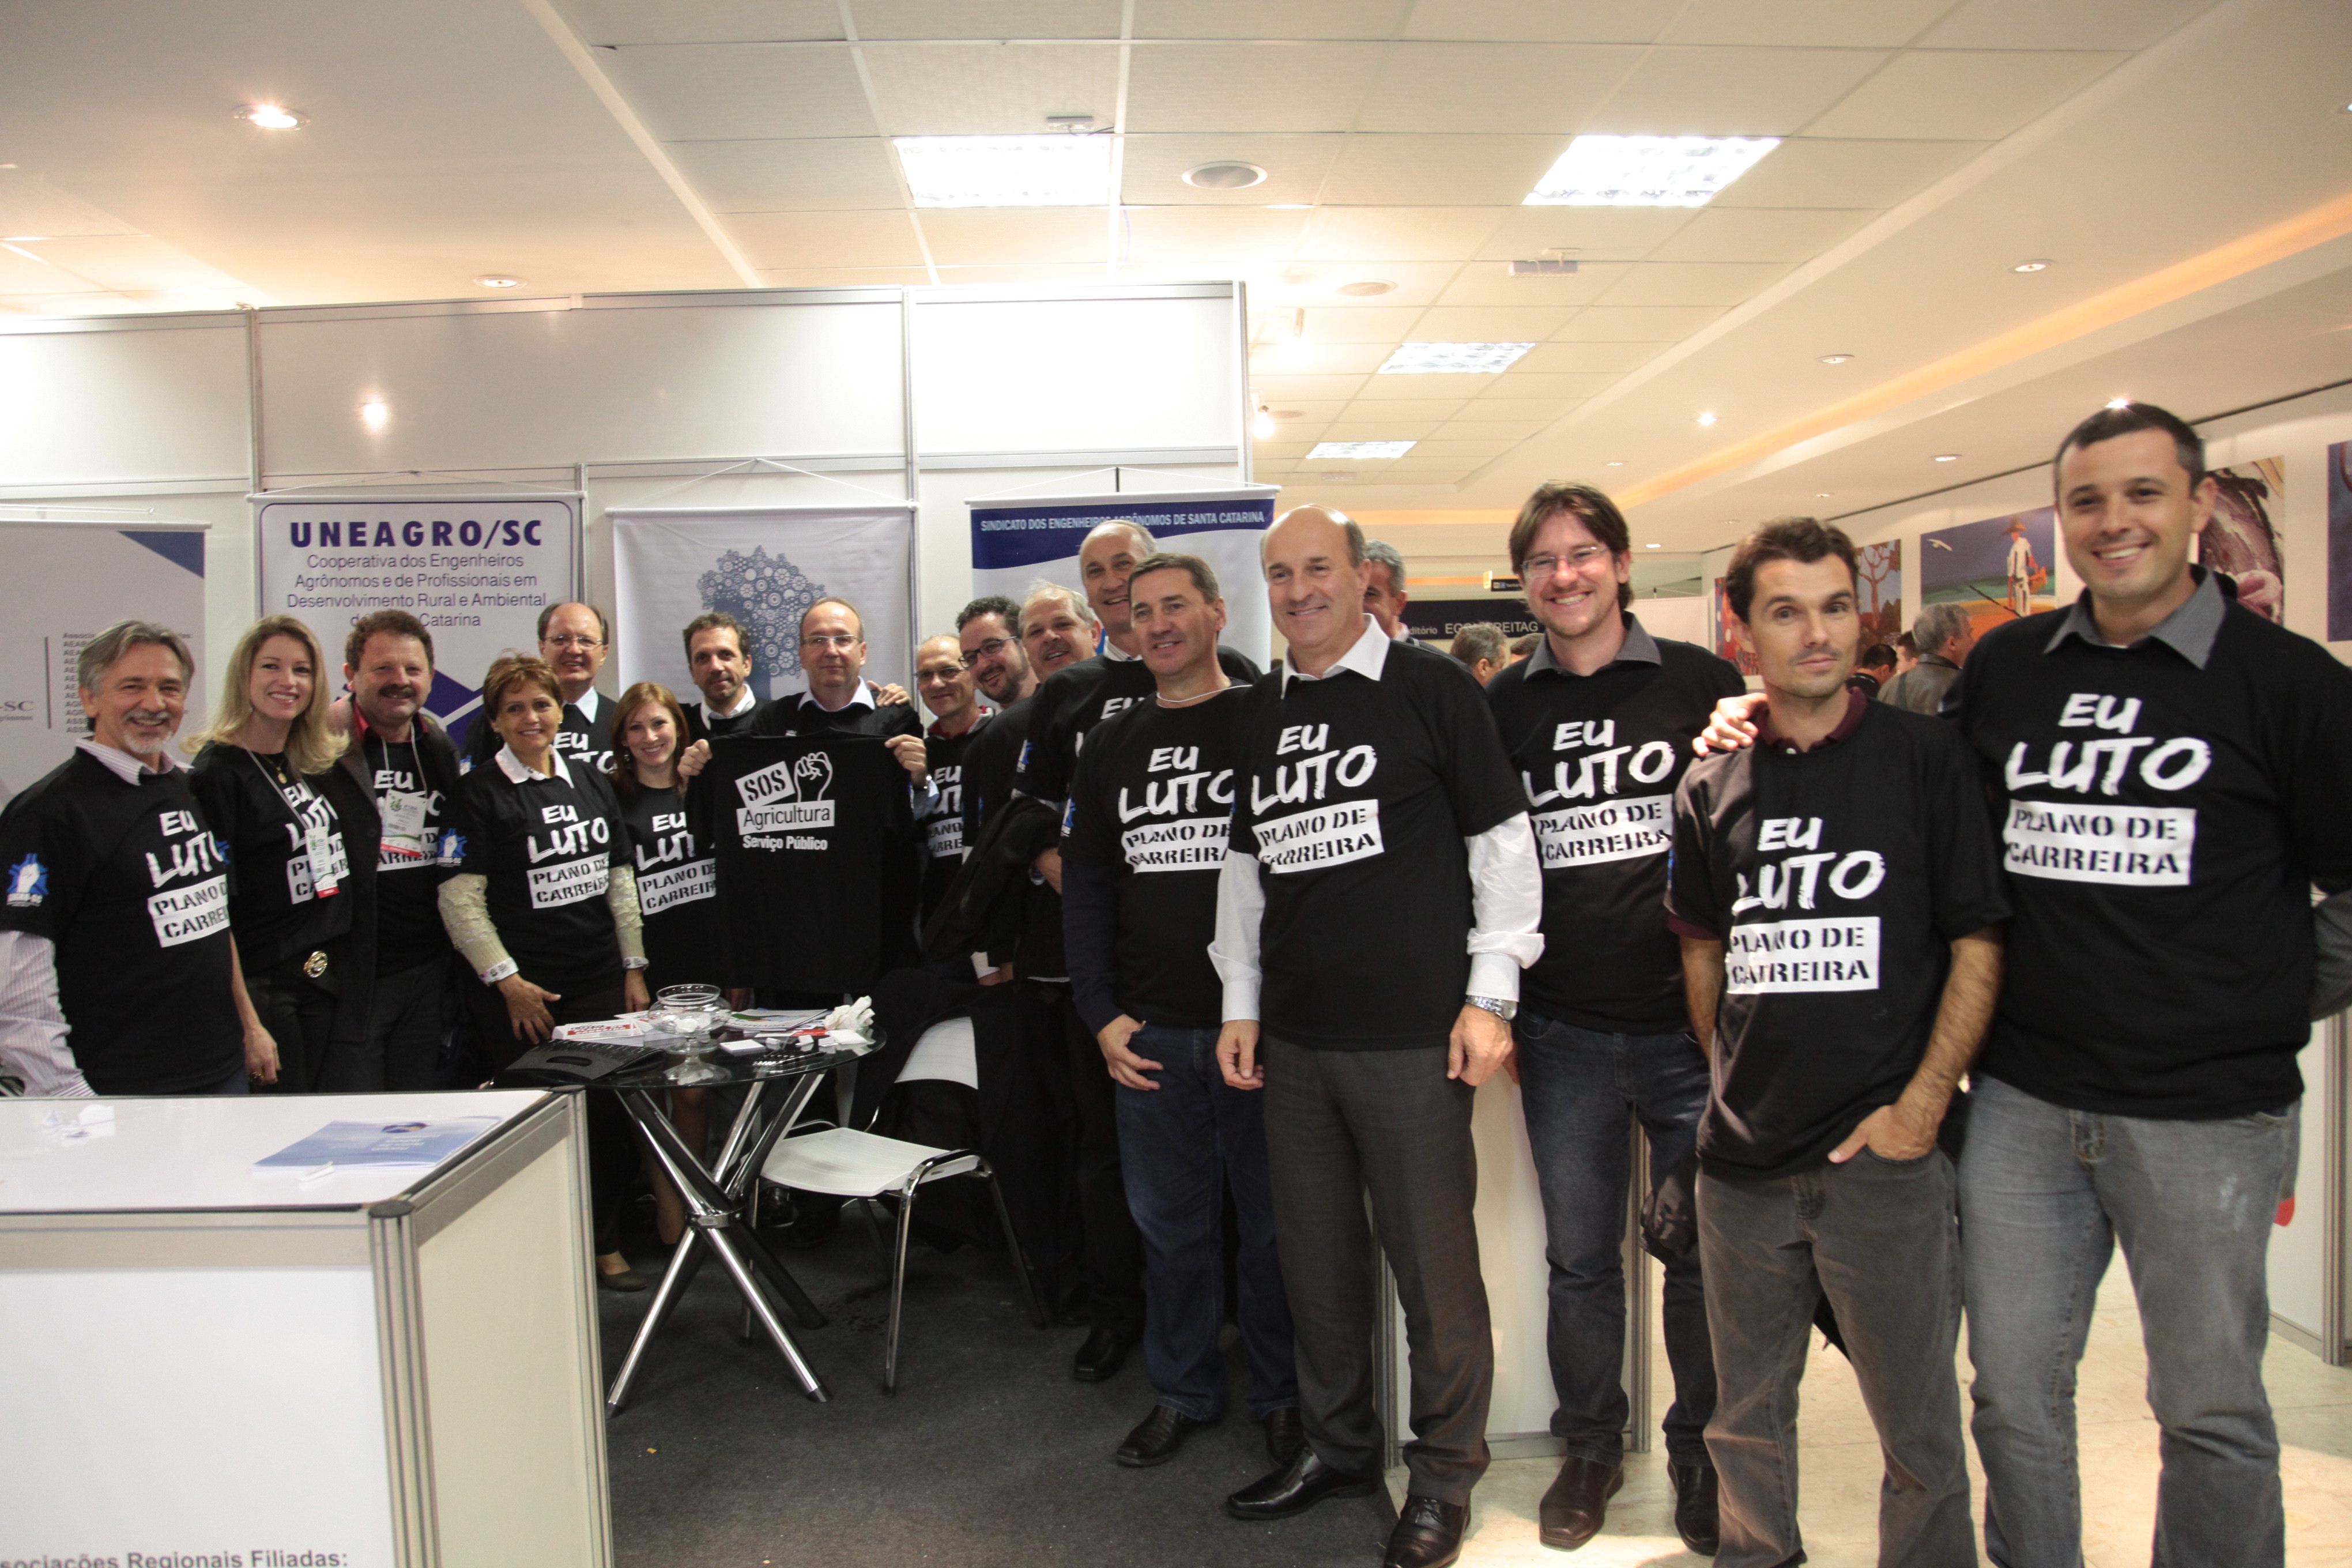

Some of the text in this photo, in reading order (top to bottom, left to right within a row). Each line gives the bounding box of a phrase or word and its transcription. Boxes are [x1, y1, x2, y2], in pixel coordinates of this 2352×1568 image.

[981, 519, 1027, 531] SINDICATO
[1028, 519, 1046, 529] DOS
[1049, 517, 1111, 529] ENGENHEIR
[1173, 514, 1186, 525] DE
[1188, 513, 1217, 524] SANTA
[1219, 511, 1265, 523] CATARINA
[291, 520, 542, 549] UNEAGRO/SC
[307, 553, 524, 571] Cooperativa dos Engenheiros
[295, 573, 537, 590] Agrônomos e de Profissionais em
[288, 592, 546, 608] Desenvolvimento Rural e Ambiental
[419, 613, 481, 627] Catarina
[1409, 627, 1438, 635] ditório
[1497, 621, 1539, 633] REITAG
[2058, 693, 2142, 734] EU
[554, 732, 589, 751] EU
[1276, 723, 1329, 755] EU
[1552, 719, 1615, 751] EU
[1147, 747, 1199, 772] EU
[2005, 736, 2212, 796] LUTO
[374, 770, 414, 790] EU
[744, 769, 786, 801] SOS
[934, 766, 962, 784] EU
[1251, 745, 1377, 816] LUTO
[1522, 741, 1675, 807] LUTO
[283, 783, 313, 808] EU
[159, 810, 199, 836] EU
[541, 805, 579, 824] EU
[652, 812, 687, 832] EU
[744, 805, 830, 830] Agricultura
[1259, 808, 1366, 846] PLANO DE
[1539, 802, 1663, 835] PLANO DE
[2013, 809, 2178, 840] PLANO DE
[527, 817, 609, 864] LUTO
[742, 835, 828, 852] Serviço Público
[1126, 826, 1195, 847] PLANO
[1546, 830, 1672, 861] CARREIRA
[1757, 817, 1823, 851] EU
[1261, 833, 1375, 865] CARREIRA
[2006, 842, 2180, 875] CARREIRA
[533, 864, 590, 885] PLANO
[643, 868, 696, 892] PLANO
[1731, 850, 1886, 916] LUTO
[154, 885, 218, 915] PLANO
[647, 880, 716, 909] CARREIR
[1731, 927, 1864, 954] PLANO DE
[0, 1550, 349, 1568] sociações Regionais Filiadas:
